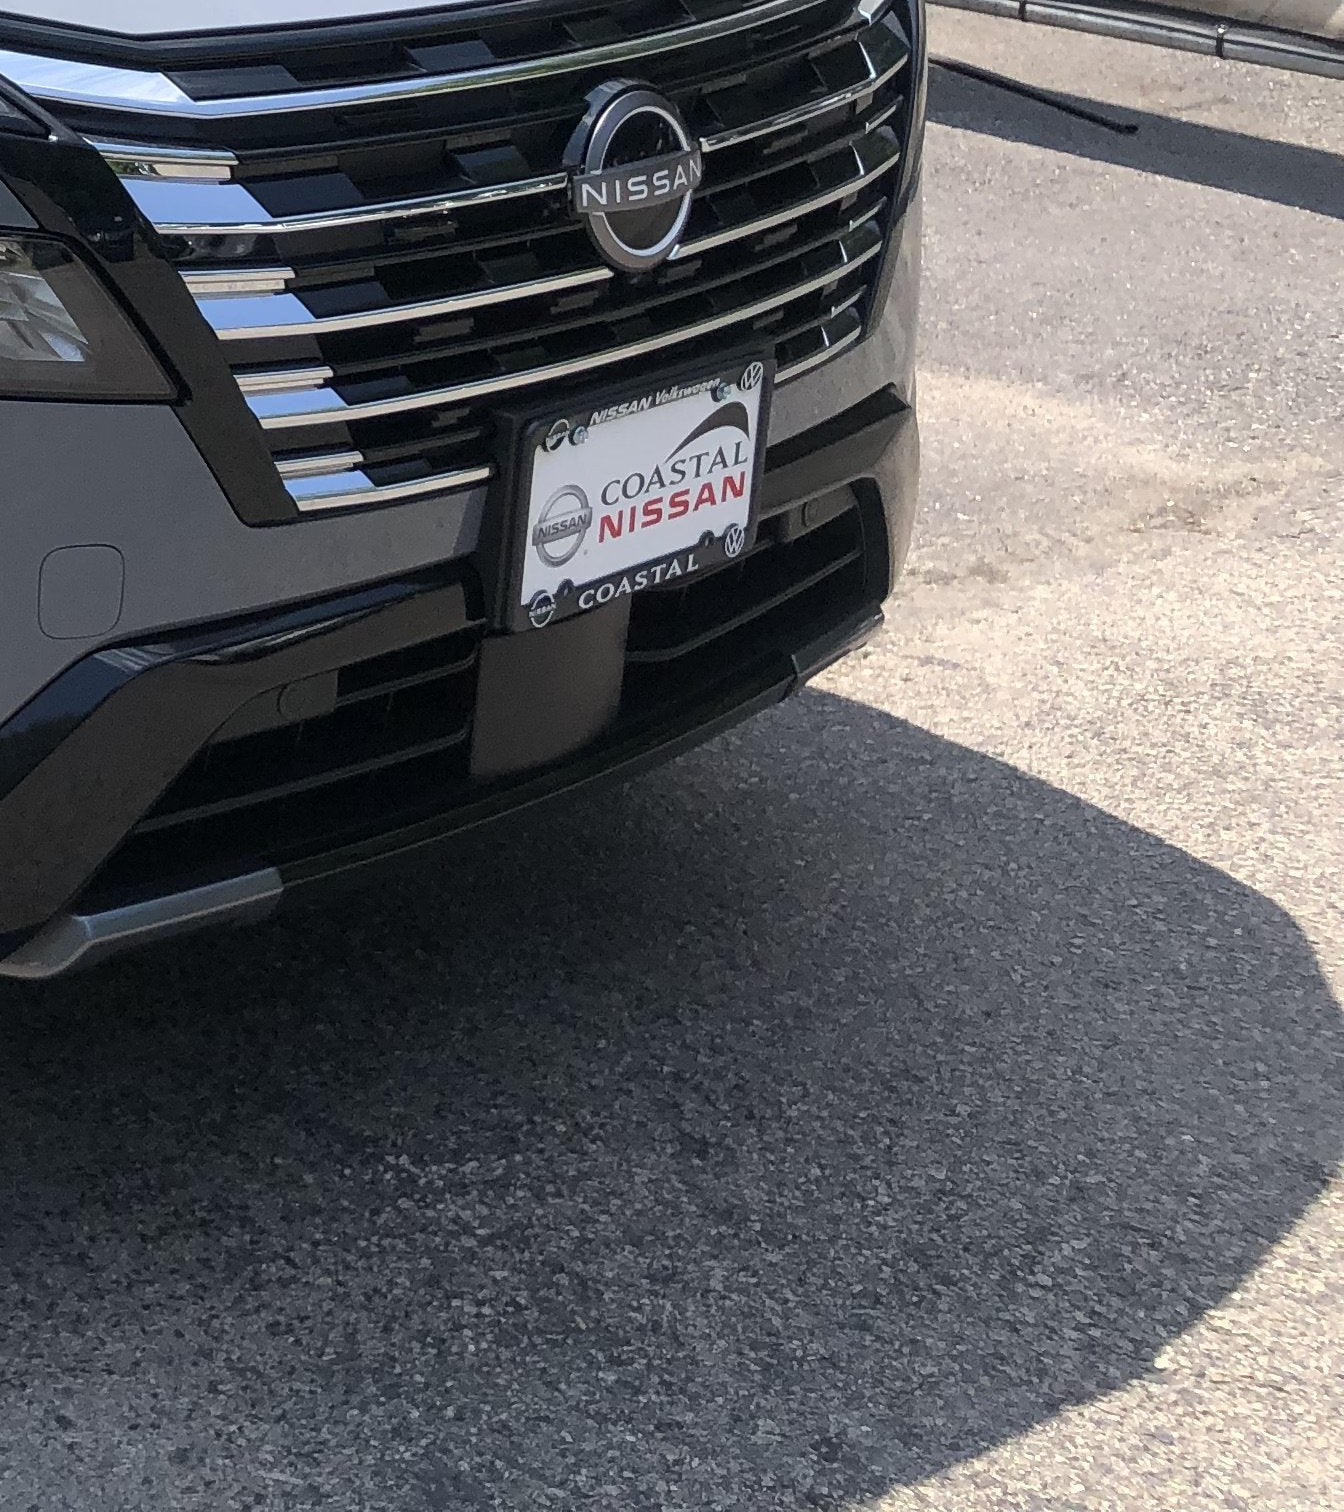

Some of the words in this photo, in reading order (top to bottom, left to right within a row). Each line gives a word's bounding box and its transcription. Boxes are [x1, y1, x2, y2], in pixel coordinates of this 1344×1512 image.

[581, 158, 702, 207] NISSAN
[590, 397, 652, 426] NISSAN
[600, 441, 748, 506] COASTAL
[538, 513, 587, 539] NISSAN
[598, 471, 746, 543] NISSAN
[577, 554, 699, 610] COASTAL
